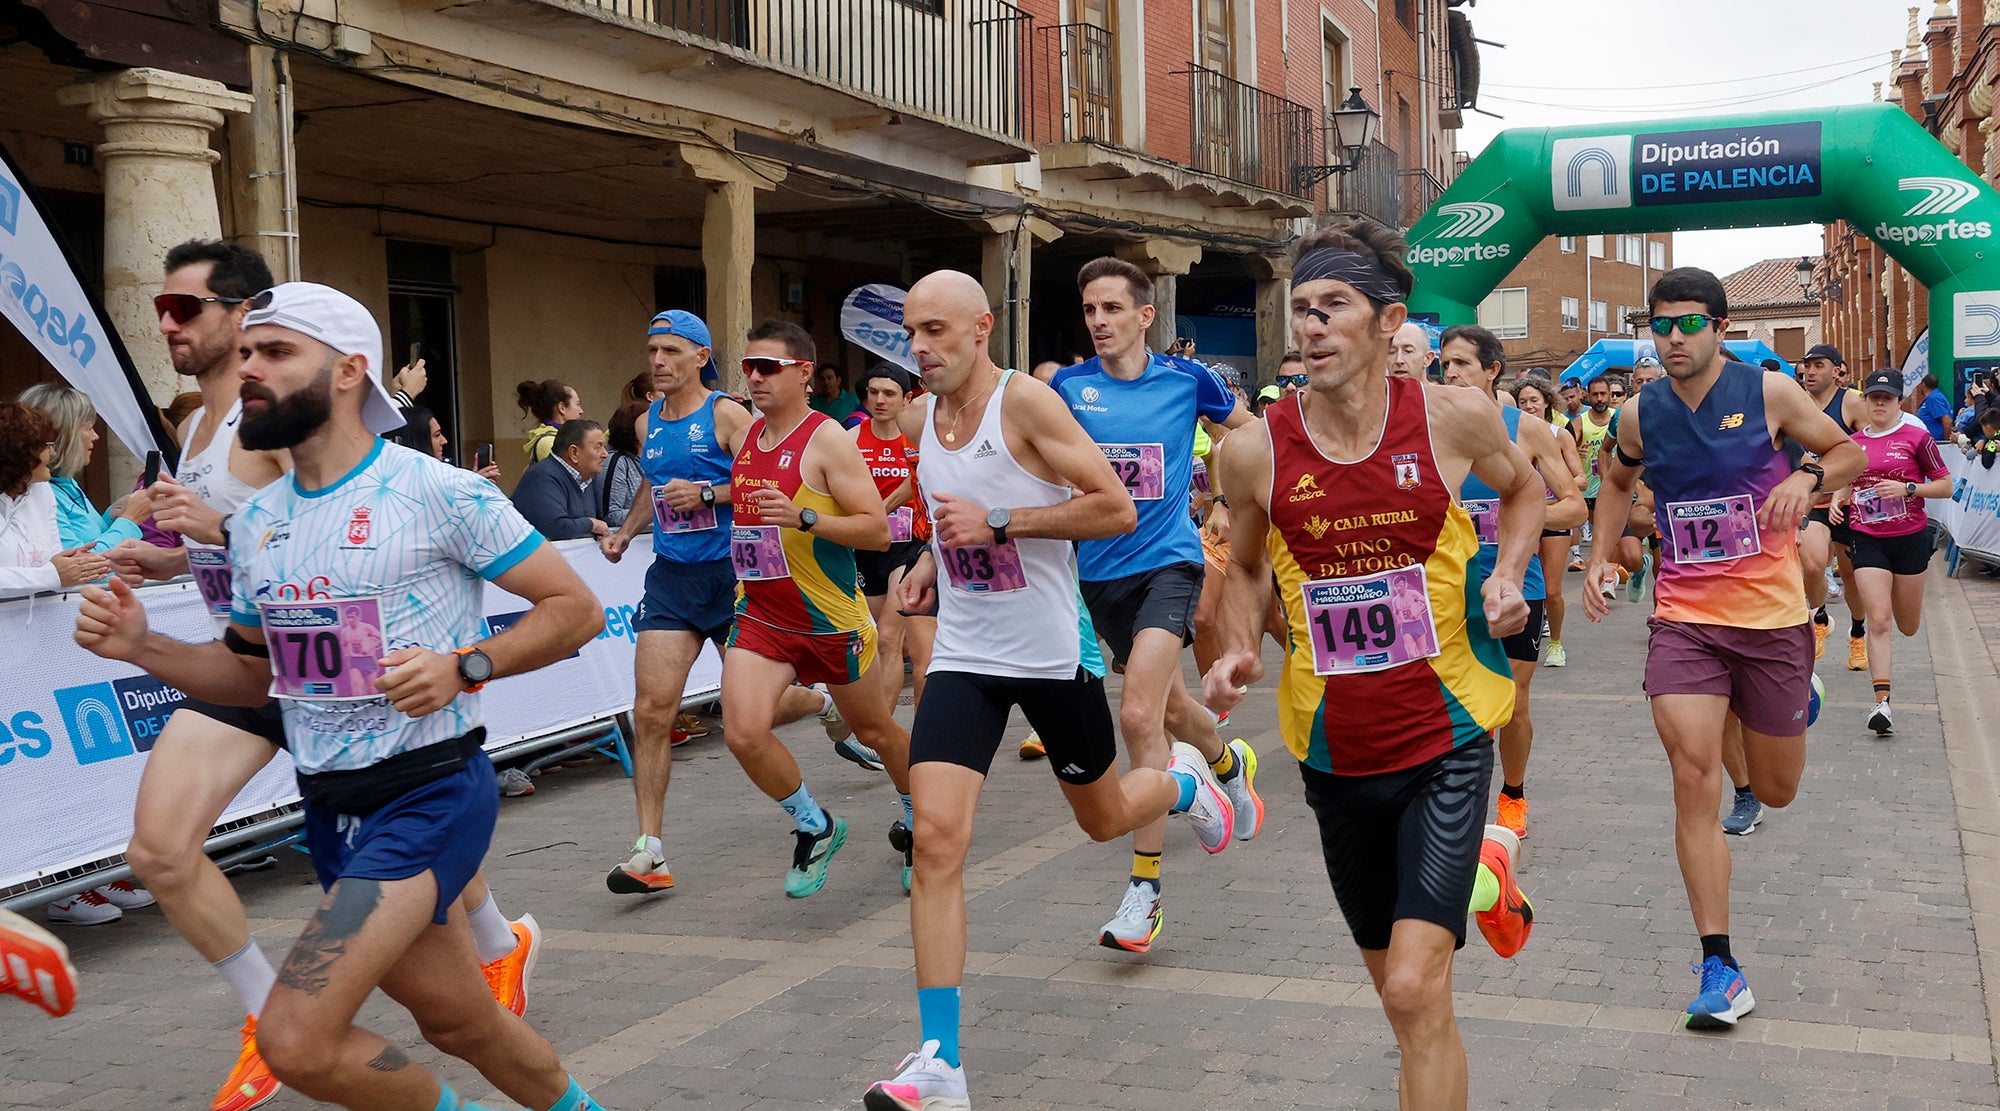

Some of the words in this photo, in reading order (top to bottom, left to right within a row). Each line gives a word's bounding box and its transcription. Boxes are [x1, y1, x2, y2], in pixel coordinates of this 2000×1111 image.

[1641, 136, 1780, 167] Diputación
[1641, 172, 1676, 194] DE
[1685, 163, 1814, 192] PALENCIA
[1875, 219, 1992, 247] deportes
[1407, 241, 1511, 266] deportes
[1072, 403, 1086, 411] Ural
[1087, 404, 1109, 412] Motor
[974, 450, 998, 460] adidas
[734, 504, 744, 513] DE
[1333, 517, 1369, 532] CAJA
[1371, 509, 1419, 526] RURAL
[1684, 519, 1722, 549] 12
[735, 542, 758, 569] 43
[1334, 537, 1392, 558] VINO
[943, 547, 995, 580] 183
[1320, 562, 1347, 578] DE
[1351, 552, 1413, 574] TORO
[1327, 584, 1365, 597] 10.000
[1356, 589, 1383, 601] HARO
[1315, 603, 1397, 653] 149
[269, 631, 342, 678] 170
[133, 718, 160, 739] DE
